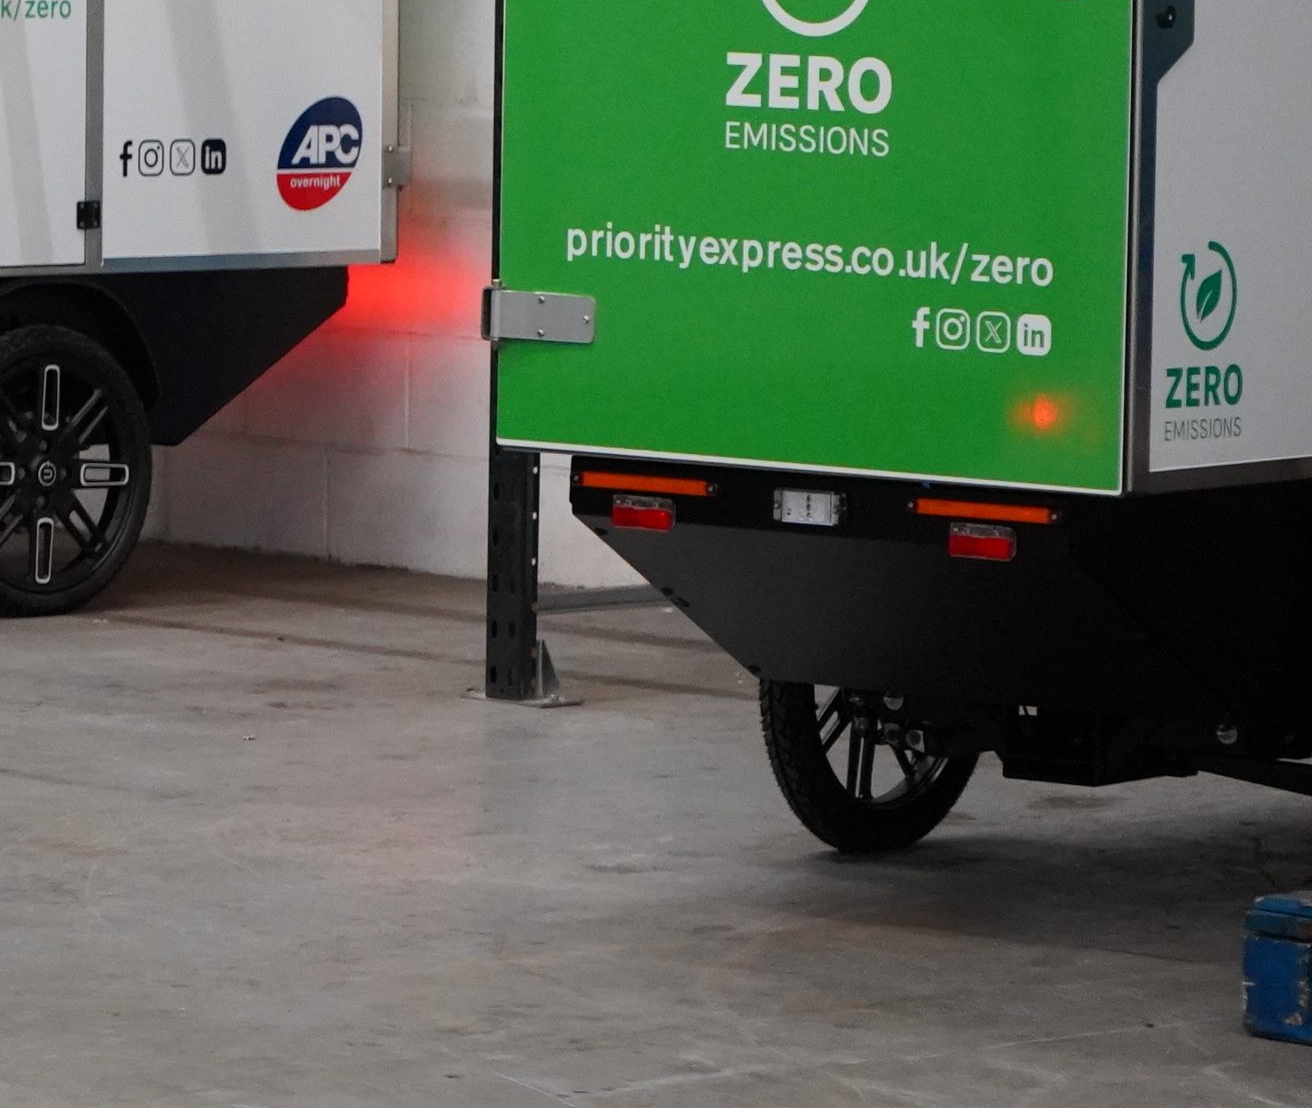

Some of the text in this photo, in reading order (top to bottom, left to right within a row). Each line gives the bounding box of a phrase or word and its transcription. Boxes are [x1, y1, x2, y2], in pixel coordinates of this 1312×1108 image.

[725, 52, 893, 114] ZERO
[291, 123, 359, 165] APC
[724, 120, 890, 157] EMISSIONS
[290, 174, 341, 191] overnight
[566, 221, 1054, 287] priorityexpress.co.uk/zero
[1165, 363, 1243, 409] ZERO
[1164, 416, 1242, 442] EMISSIONS
